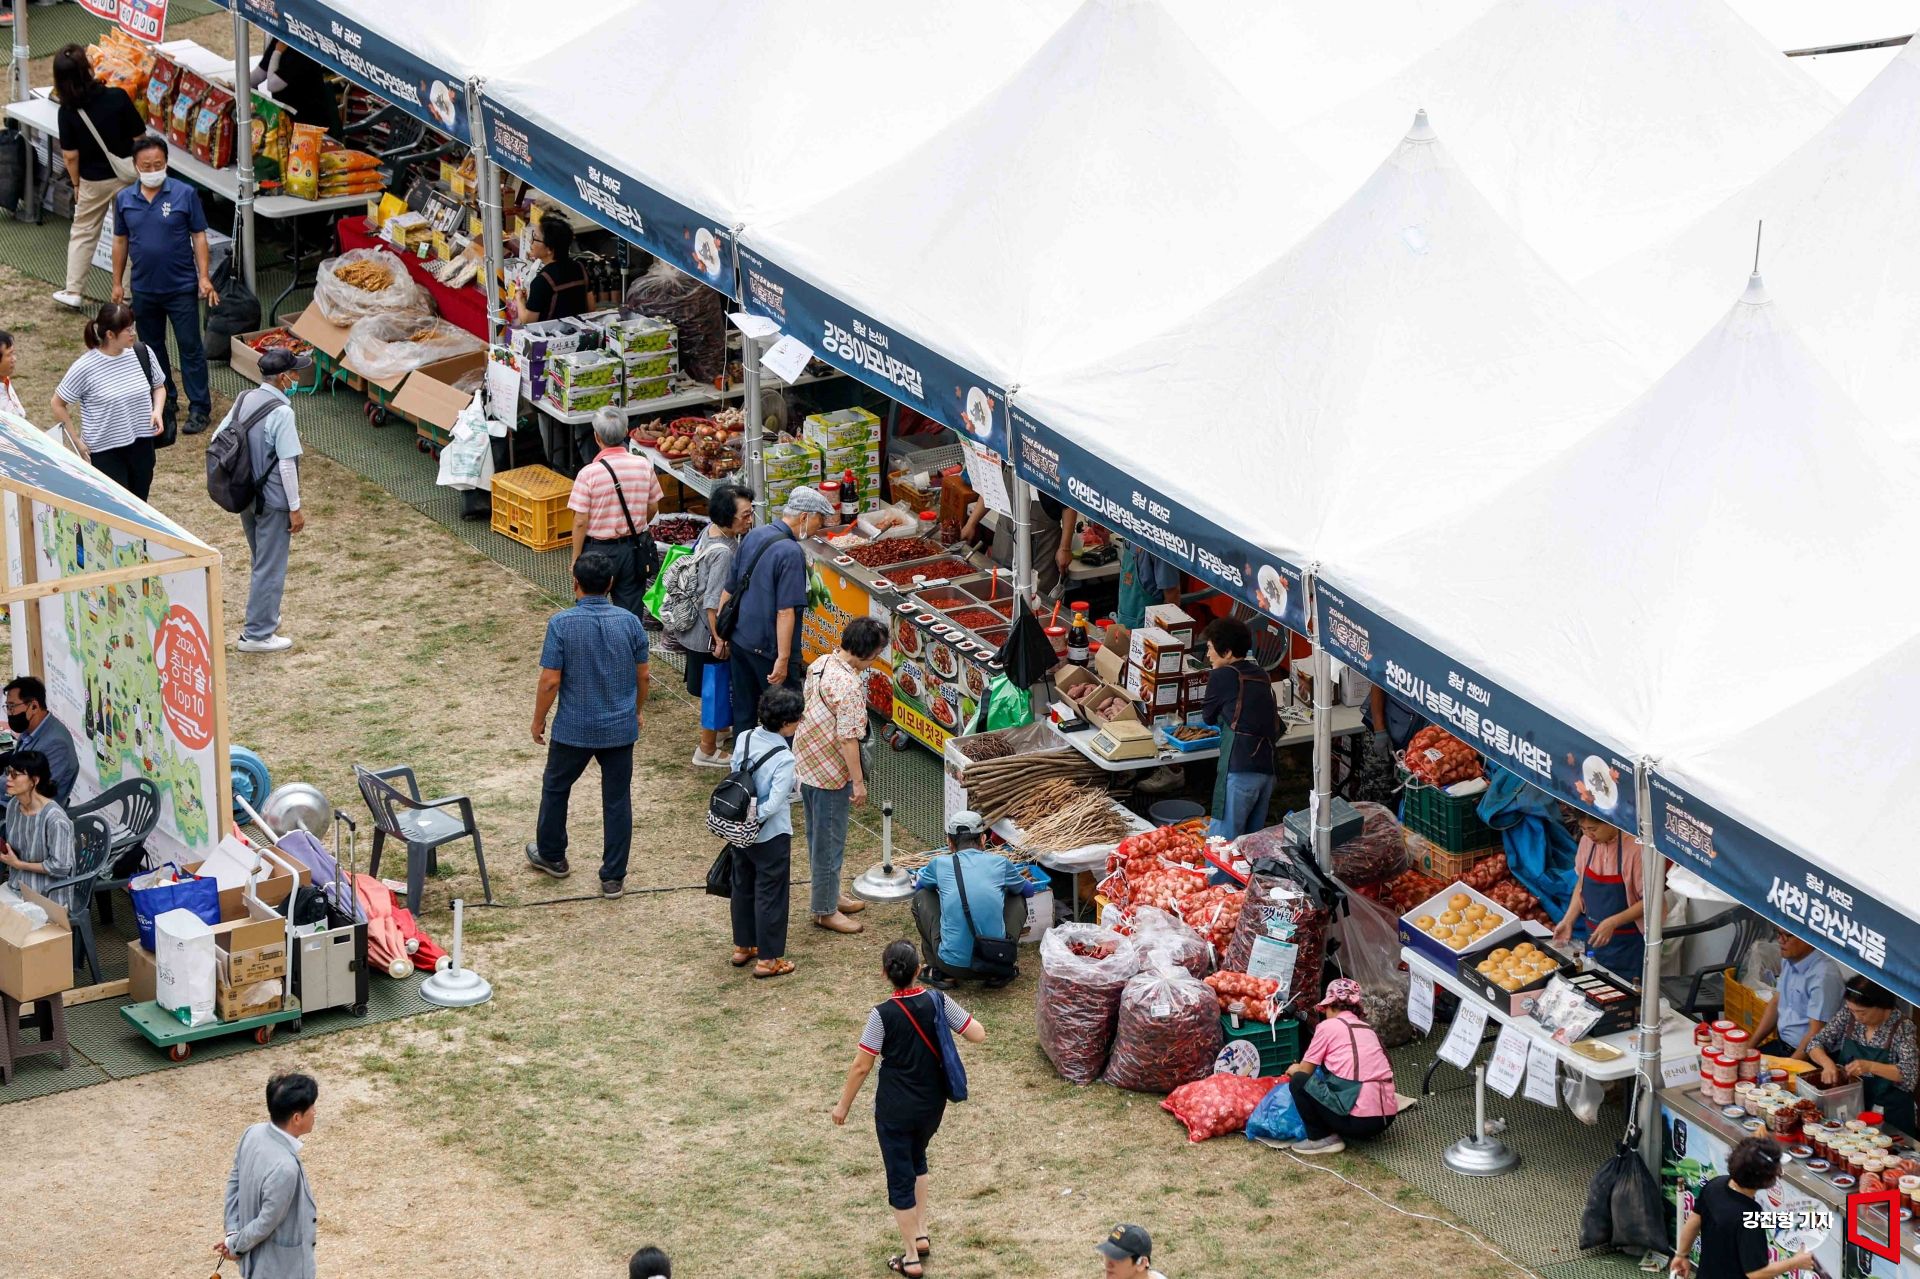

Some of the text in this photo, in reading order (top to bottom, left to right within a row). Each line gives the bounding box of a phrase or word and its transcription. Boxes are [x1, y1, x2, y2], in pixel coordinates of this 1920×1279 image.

[284, 12, 319, 48] 금산군
[332, 20, 362, 49] 충남 금산군
[588, 165, 621, 195] 충남 부여군
[853, 319, 889, 350] 충남 논산시
[822, 319, 924, 400] 강경이모네젓갈
[1067, 476, 1189, 559] 안면도사랑영농조합법인
[1131, 490, 1171, 524] 충남 태안군
[176, 634, 196, 657] 2024
[169, 650, 206, 696] 충남술
[1447, 670, 1491, 708] 충남 천안시
[897, 705, 944, 749] 이모네젓갈
[1385, 659, 1553, 780] 천안시 농특산물 유통사업단
[1806, 872, 1854, 913] 충남 서천군
[1767, 876, 1887, 970] 서천 한산식품
